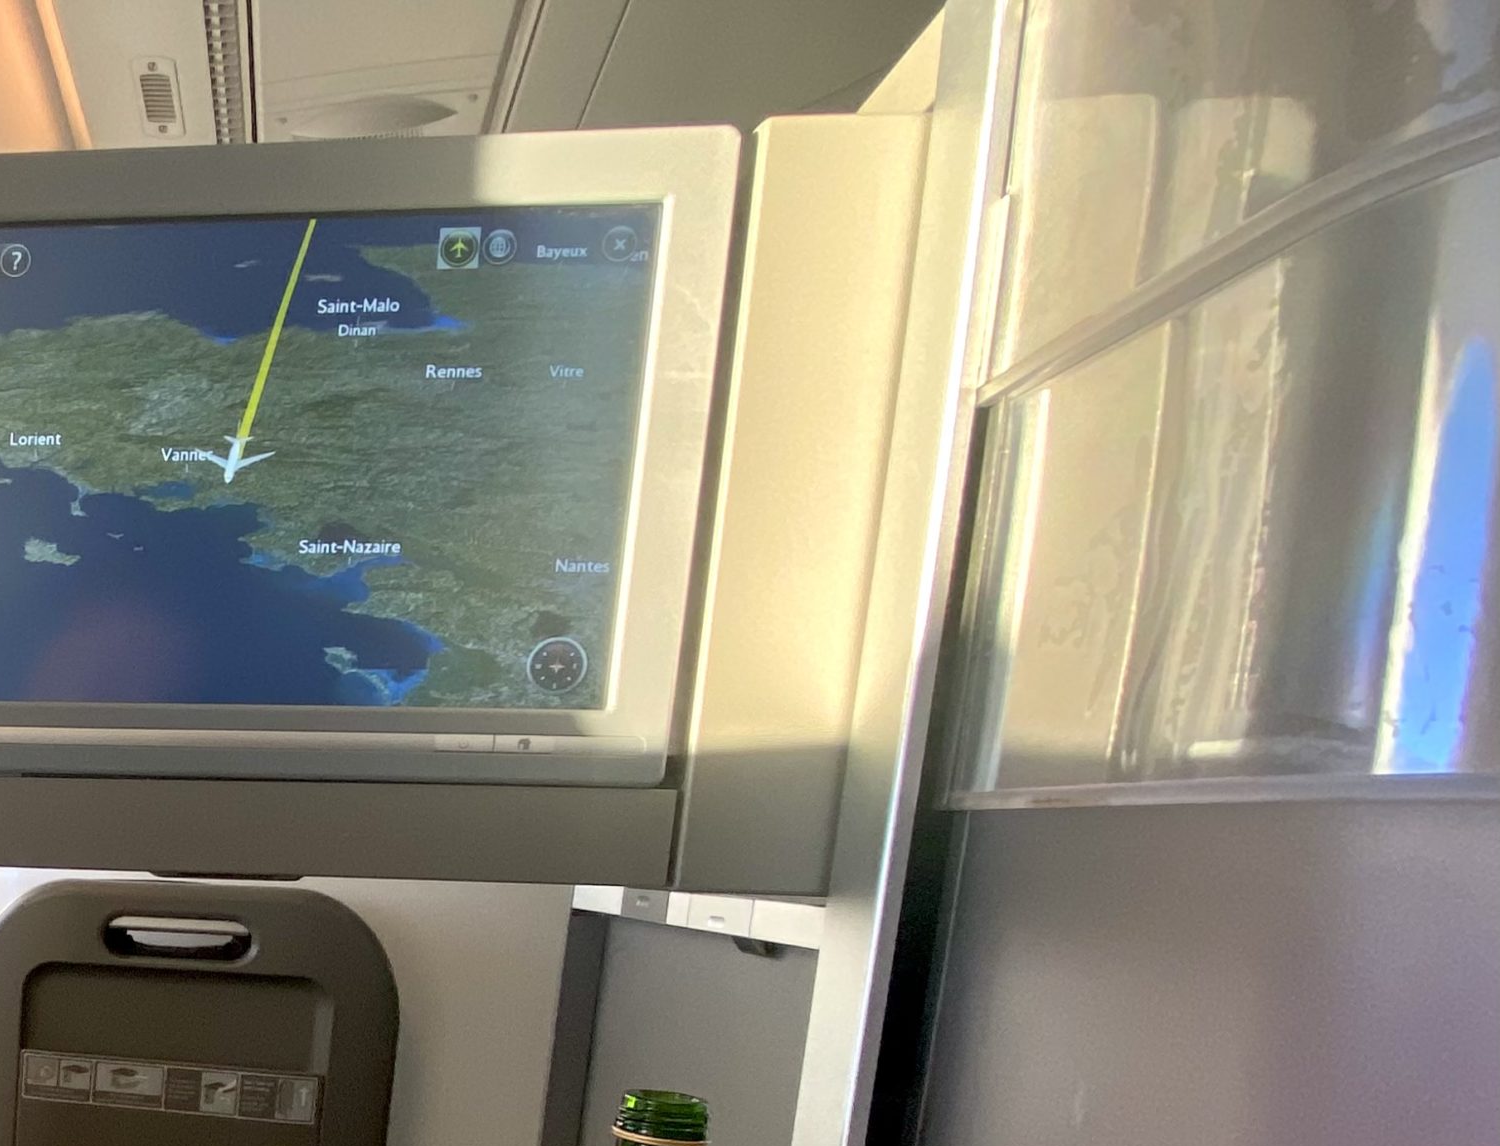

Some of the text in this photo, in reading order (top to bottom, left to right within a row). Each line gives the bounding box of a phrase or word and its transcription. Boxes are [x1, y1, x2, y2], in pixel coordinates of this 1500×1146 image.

[536, 245, 588, 261] Bayeux
[317, 298, 401, 314] Saint-Malo
[337, 324, 377, 337] Dinan
[425, 365, 483, 379] Rennes
[549, 364, 584, 378] Vitre
[9, 432, 62, 447] Lorient
[298, 539, 402, 556] Saint-Nazaire
[554, 558, 610, 573] Nantes
